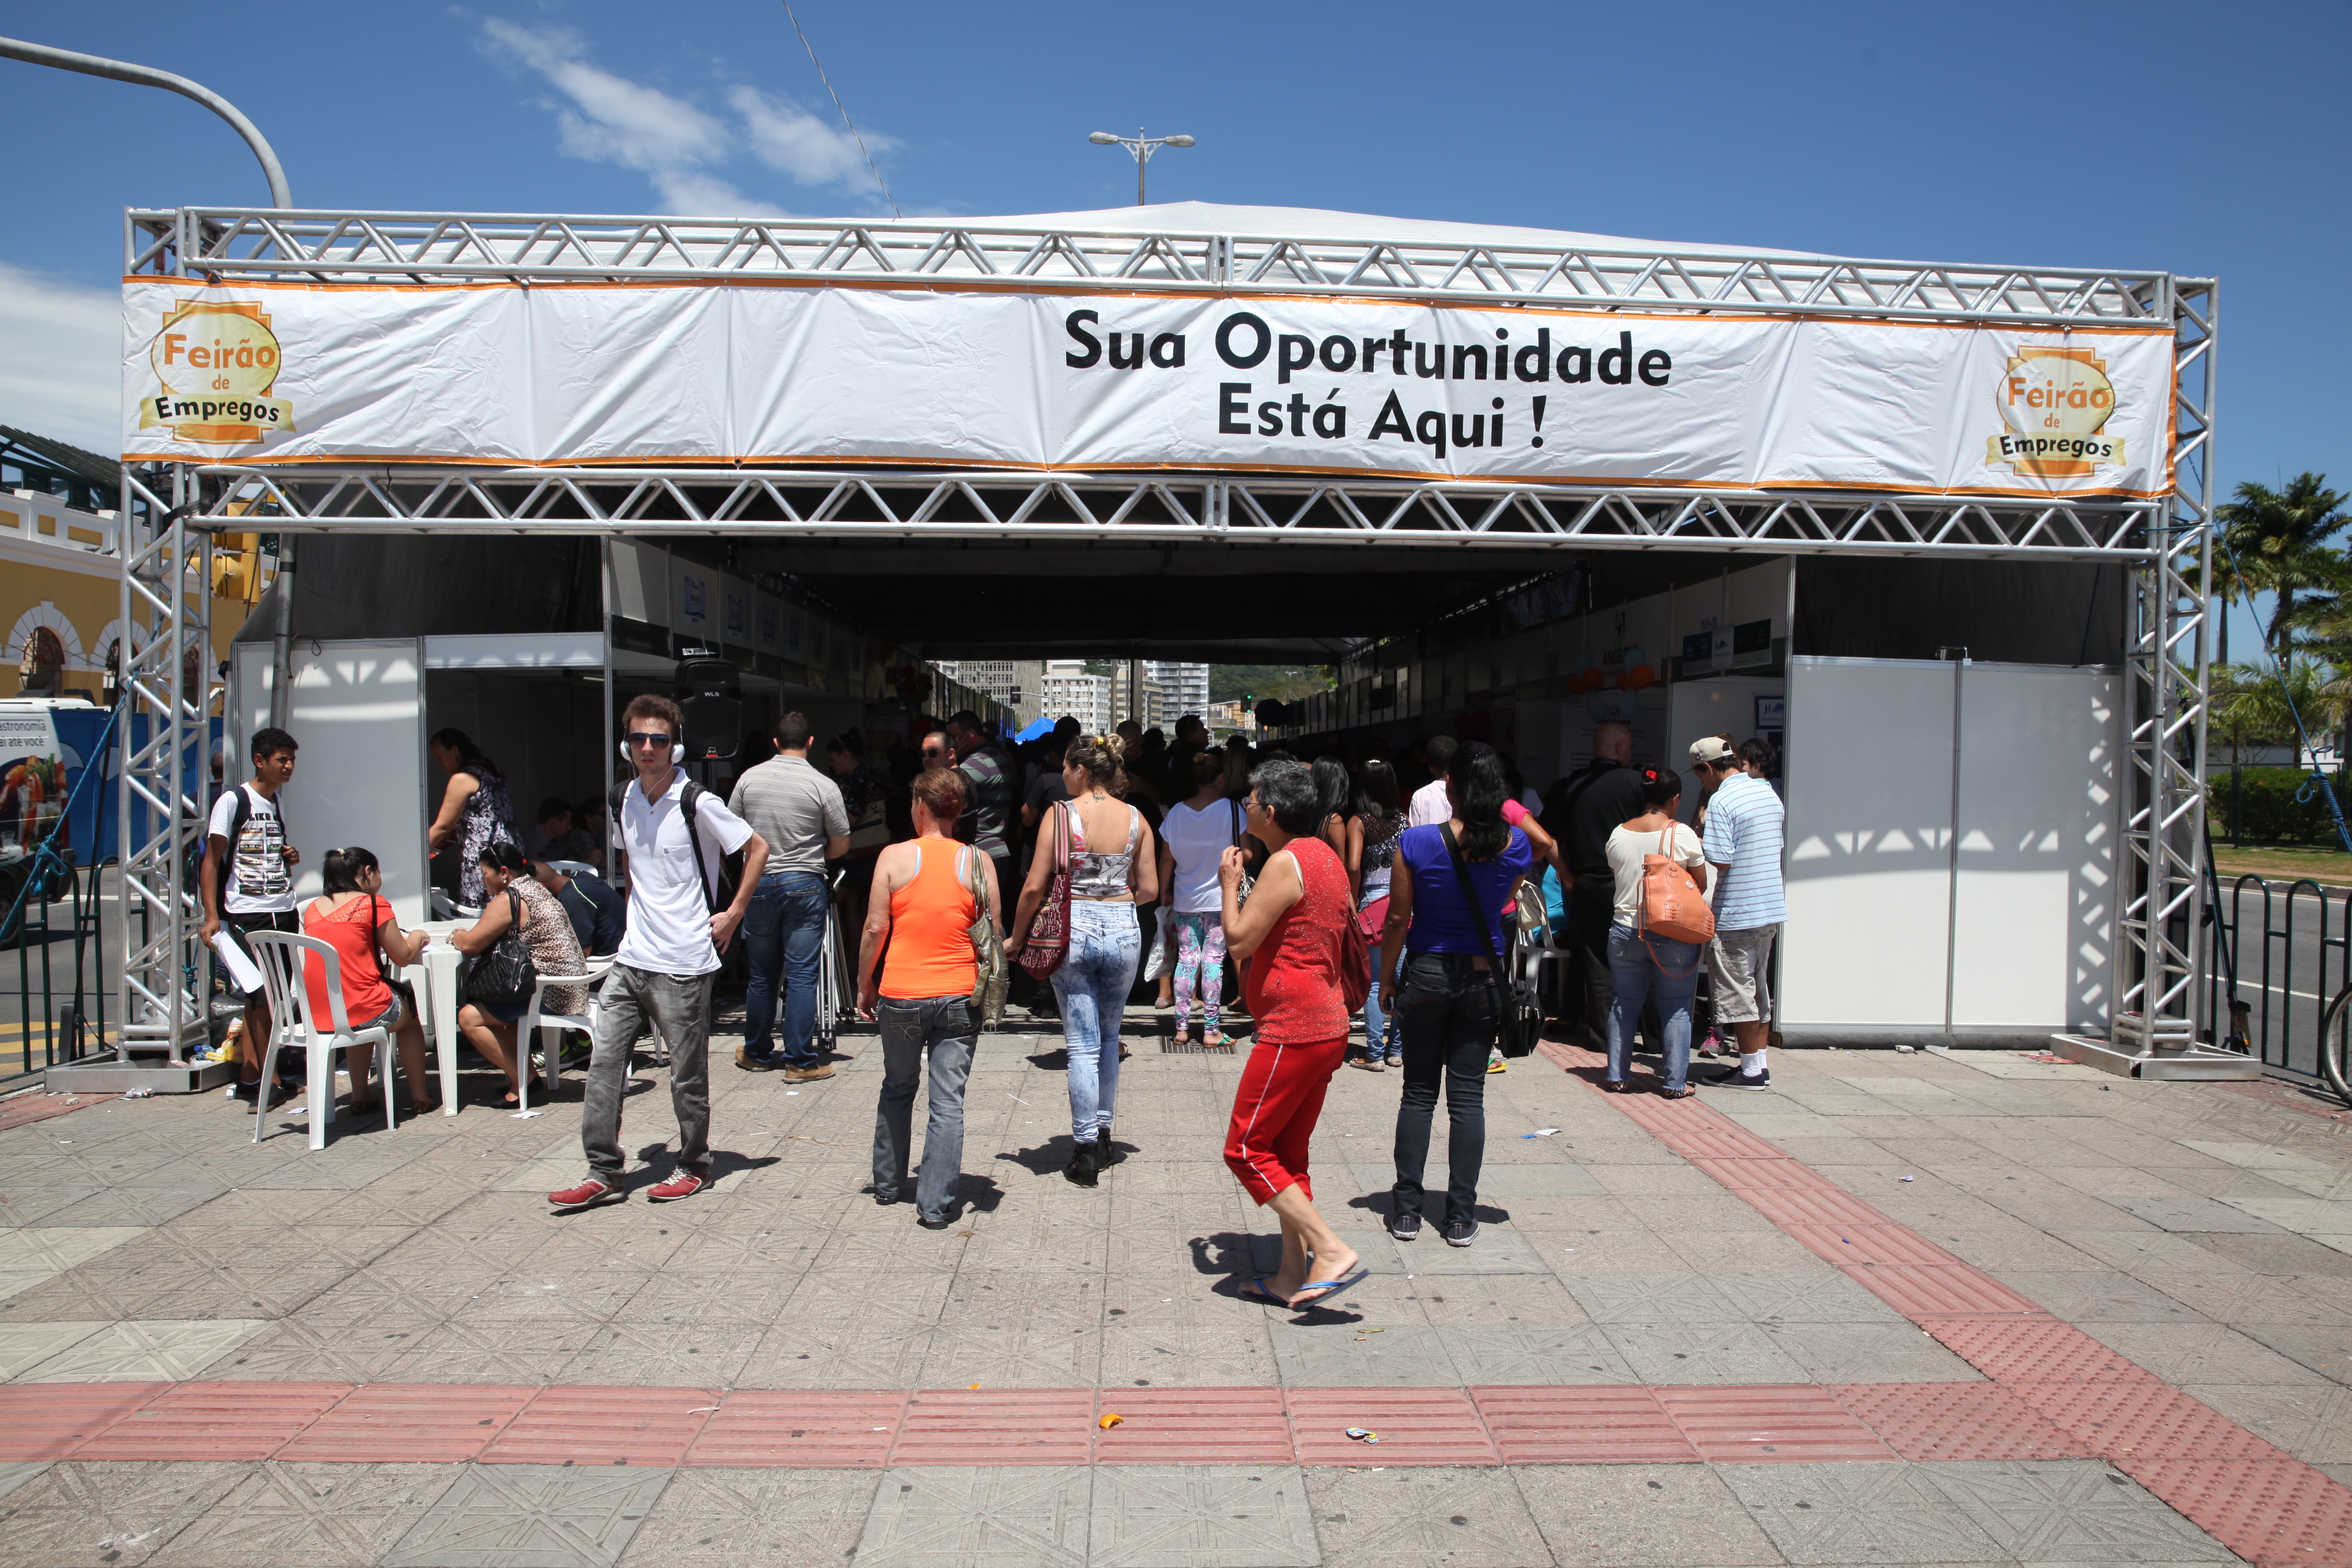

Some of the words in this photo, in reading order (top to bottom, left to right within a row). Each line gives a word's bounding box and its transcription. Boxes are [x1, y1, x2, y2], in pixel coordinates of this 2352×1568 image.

[164, 333, 276, 368] Feirão
[1065, 310, 1185, 370] Sua
[1215, 311, 1672, 386] Oportunidade
[212, 374, 229, 390] de
[2008, 377, 2110, 409] Feirão
[154, 396, 280, 422] Empregos
[1219, 382, 1346, 438] Está
[1367, 389, 1504, 459] Aqui
[2044, 413, 2060, 428] de
[1999, 435, 2113, 458] Empregos
[23, 736, 44, 747] você
